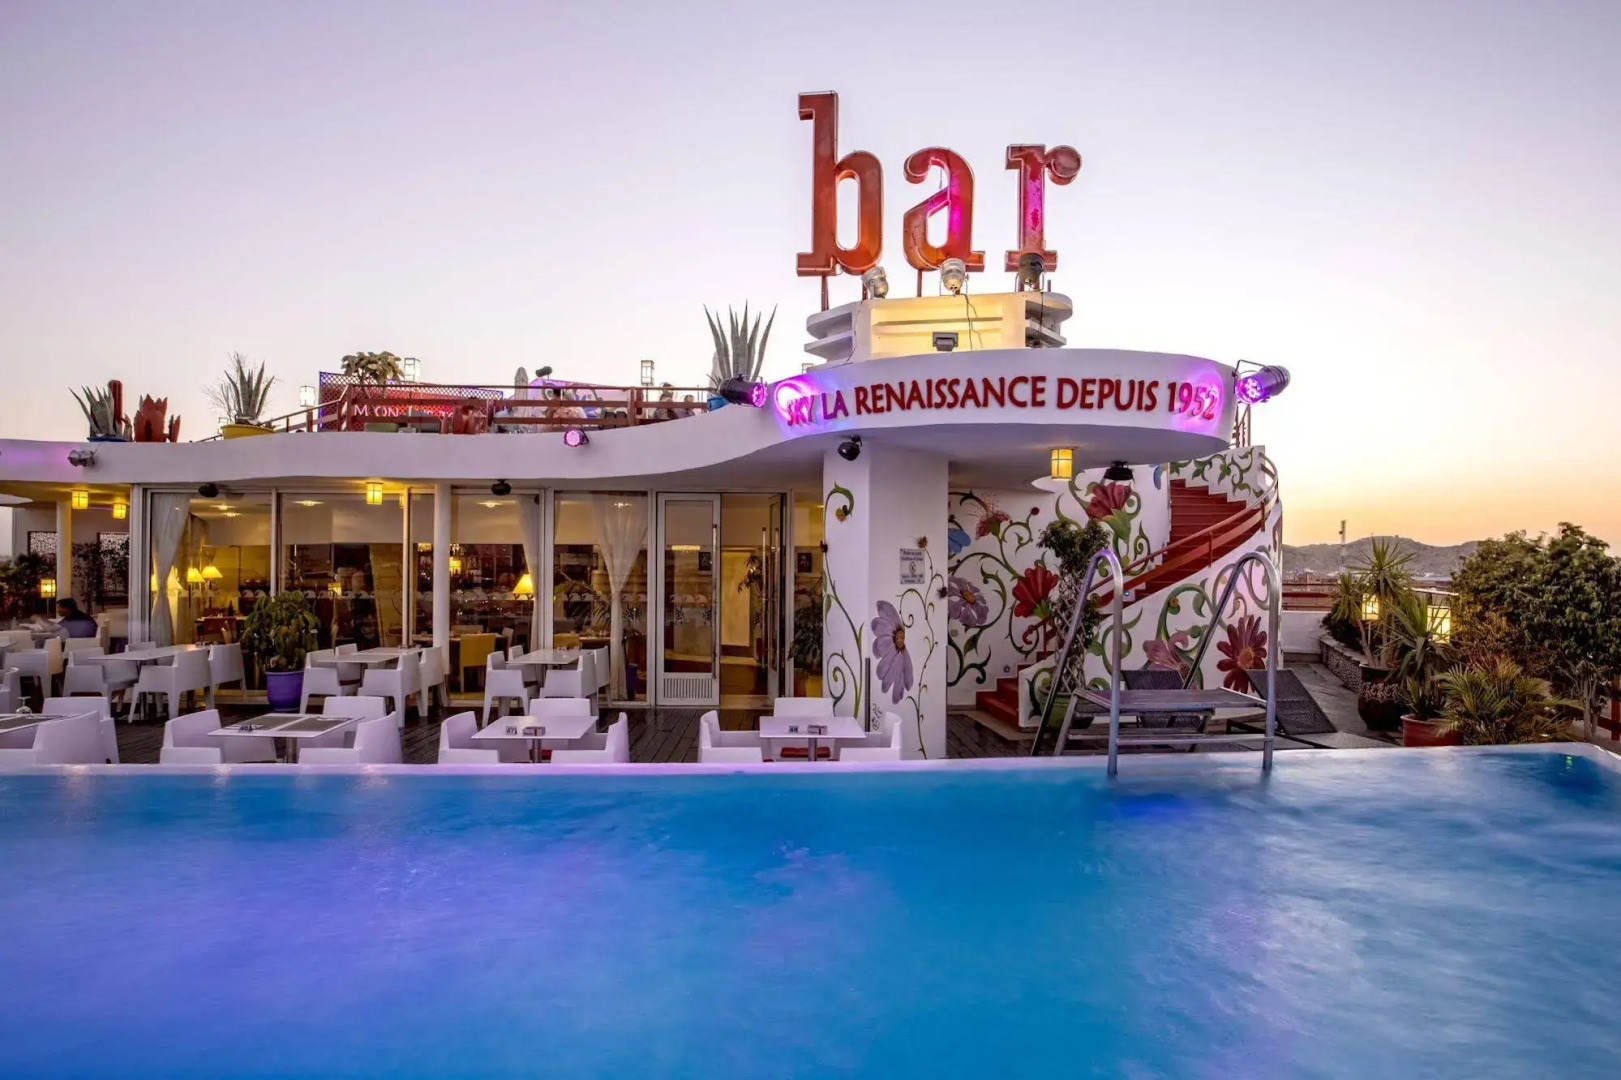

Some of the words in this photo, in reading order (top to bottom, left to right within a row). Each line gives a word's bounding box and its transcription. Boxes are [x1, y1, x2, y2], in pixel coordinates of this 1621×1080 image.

[797, 90, 1082, 277] bar
[821, 390, 849, 420] LA
[854, 376, 1047, 416] RENAISSANCE
[1057, 377, 1159, 412] DEPUIS
[1168, 382, 1217, 420] 1952
